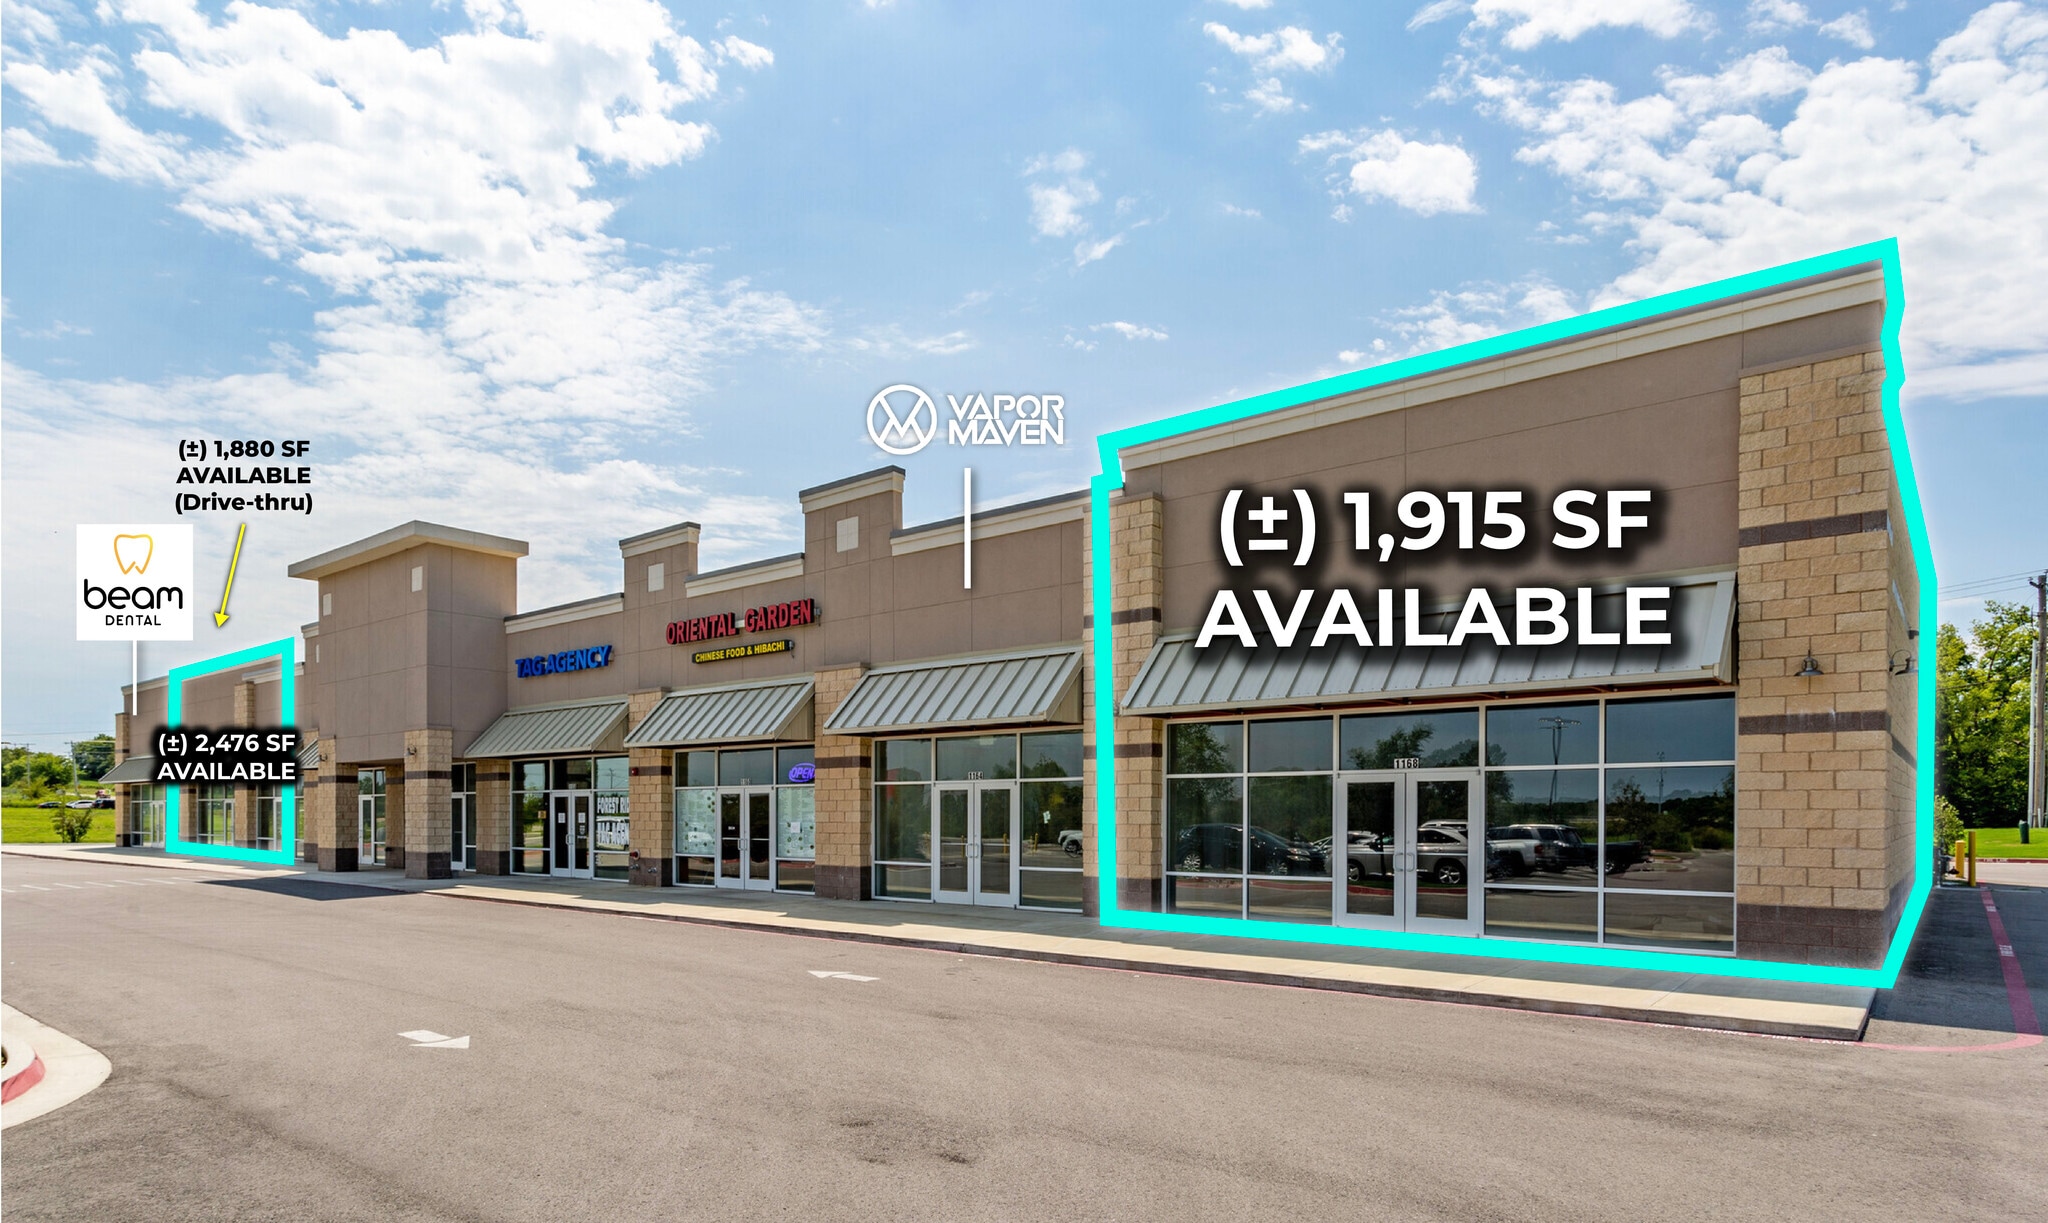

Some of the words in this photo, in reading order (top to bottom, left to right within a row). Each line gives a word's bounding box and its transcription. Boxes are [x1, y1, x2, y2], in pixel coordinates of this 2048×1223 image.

[666, 612, 739, 645] ORIENTAL
[744, 598, 814, 633] GARDEN
[515, 656, 545, 678] TAG
[545, 644, 612, 674] AGENCY
[695, 652, 725, 663] CHINESE
[725, 646, 745, 659] FOOD
[747, 645, 753, 655] &
[754, 641, 785, 654] HIBACHI
[1395, 758, 1418, 768] 1168
[790, 766, 814, 780] OPEN
[597, 797, 619, 813] FOREST
